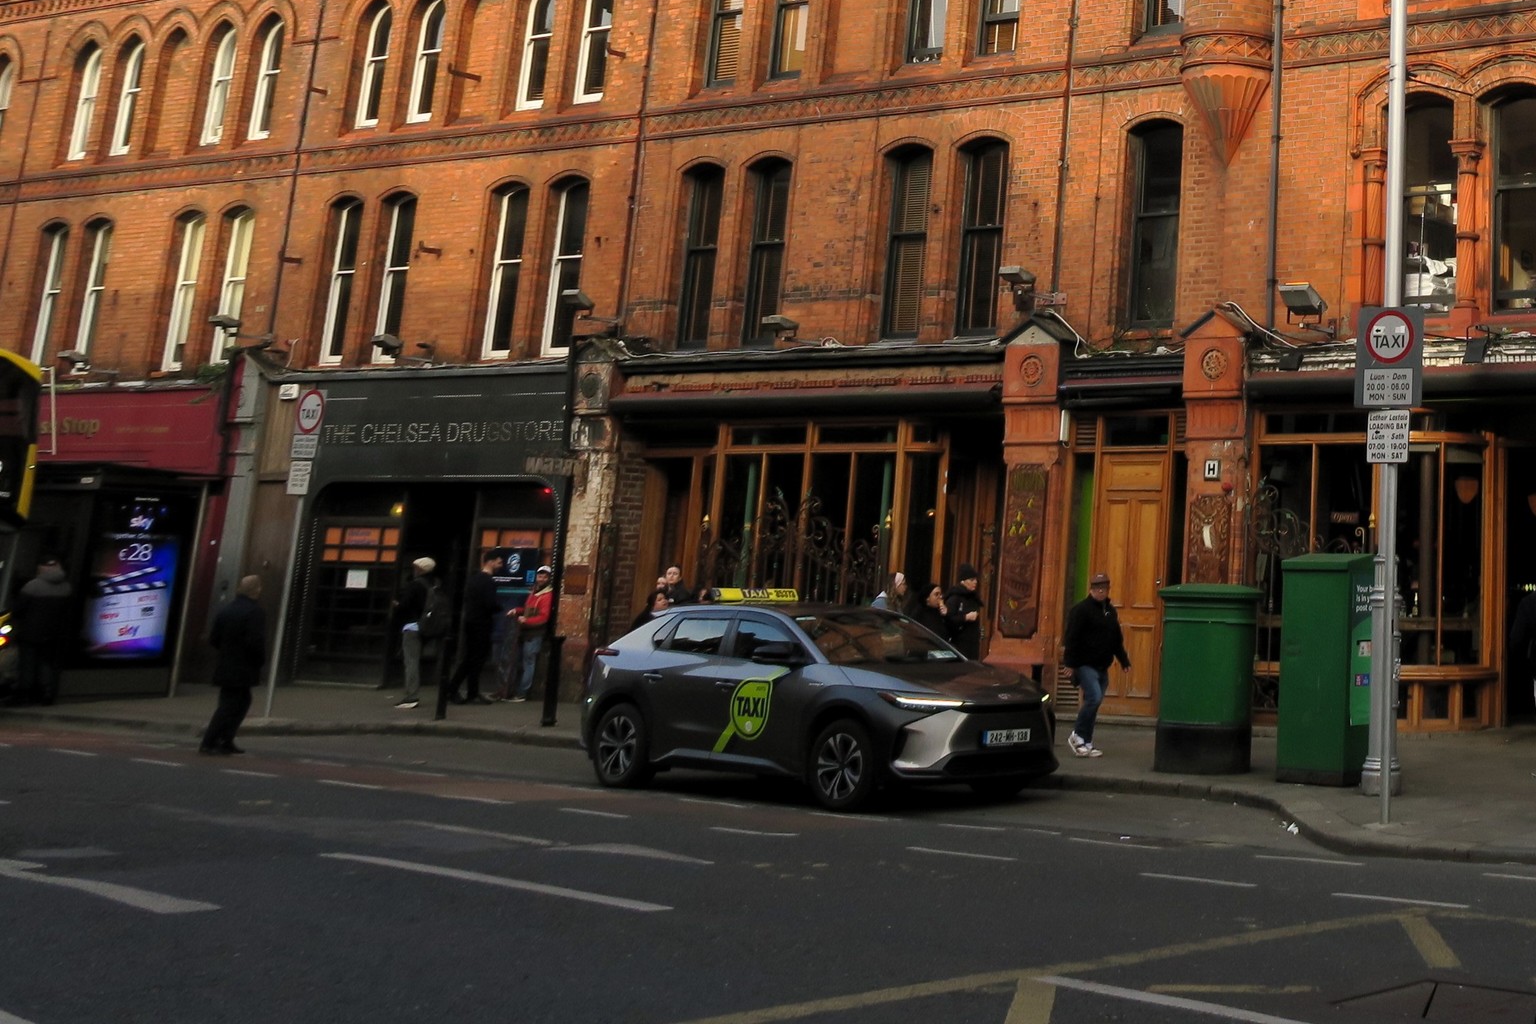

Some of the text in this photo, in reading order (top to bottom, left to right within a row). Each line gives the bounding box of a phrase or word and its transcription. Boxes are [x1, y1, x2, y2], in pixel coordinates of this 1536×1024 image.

[1373, 335, 1406, 349] TAXI
[1370, 373, 1386, 381] Luan
[1366, 383, 1386, 391] 20.00
[1368, 393, 1386, 401] MON
[1392, 393, 1407, 401] SUN
[303, 408, 319, 420] TAXI
[324, 424, 356, 443] THE
[361, 423, 441, 443] CHELSEA
[1371, 452, 1403, 460] MON SAT
[1207, 464, 1216, 475] H
[130, 516, 154, 530] sky
[119, 543, 153, 561] €28
[743, 589, 767, 598] TAXI
[1356, 585, 1368, 593] Your
[1355, 604, 1369, 613] post
[118, 625, 139, 637] sky
[737, 697, 765, 718] TAXI
